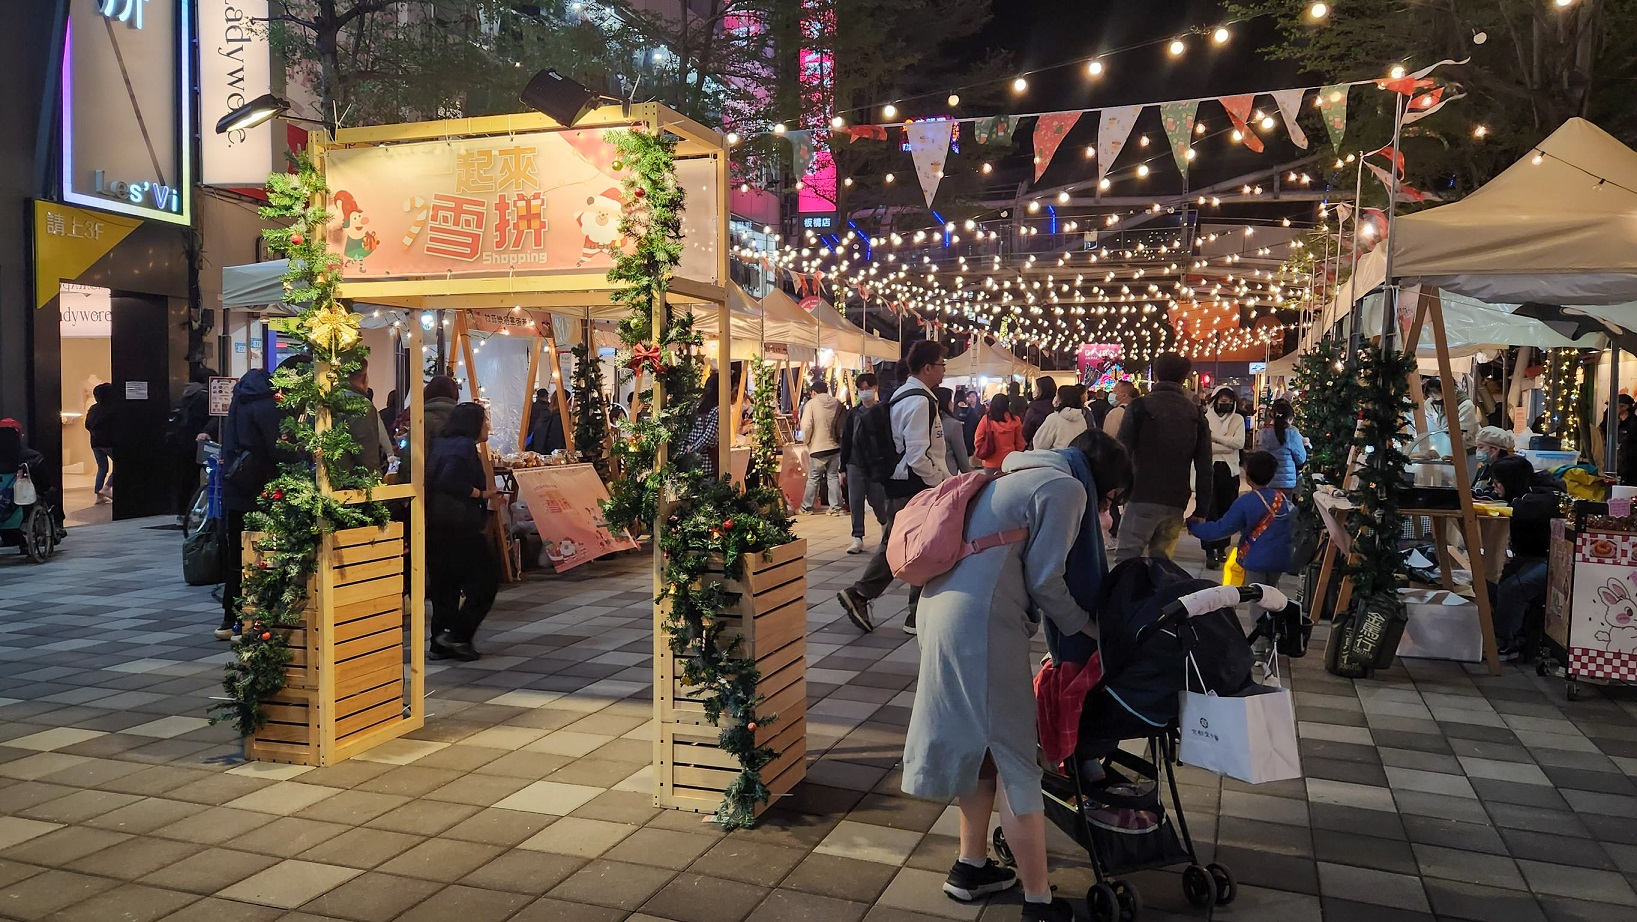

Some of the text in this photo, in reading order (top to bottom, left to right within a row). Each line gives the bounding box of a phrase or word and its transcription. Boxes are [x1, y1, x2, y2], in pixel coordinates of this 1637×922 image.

[425, 191, 548, 262] 雪拼
[803, 217, 831, 228] 板橋店
[482, 250, 547, 265] Shopping
[60, 306, 111, 326] dywore
